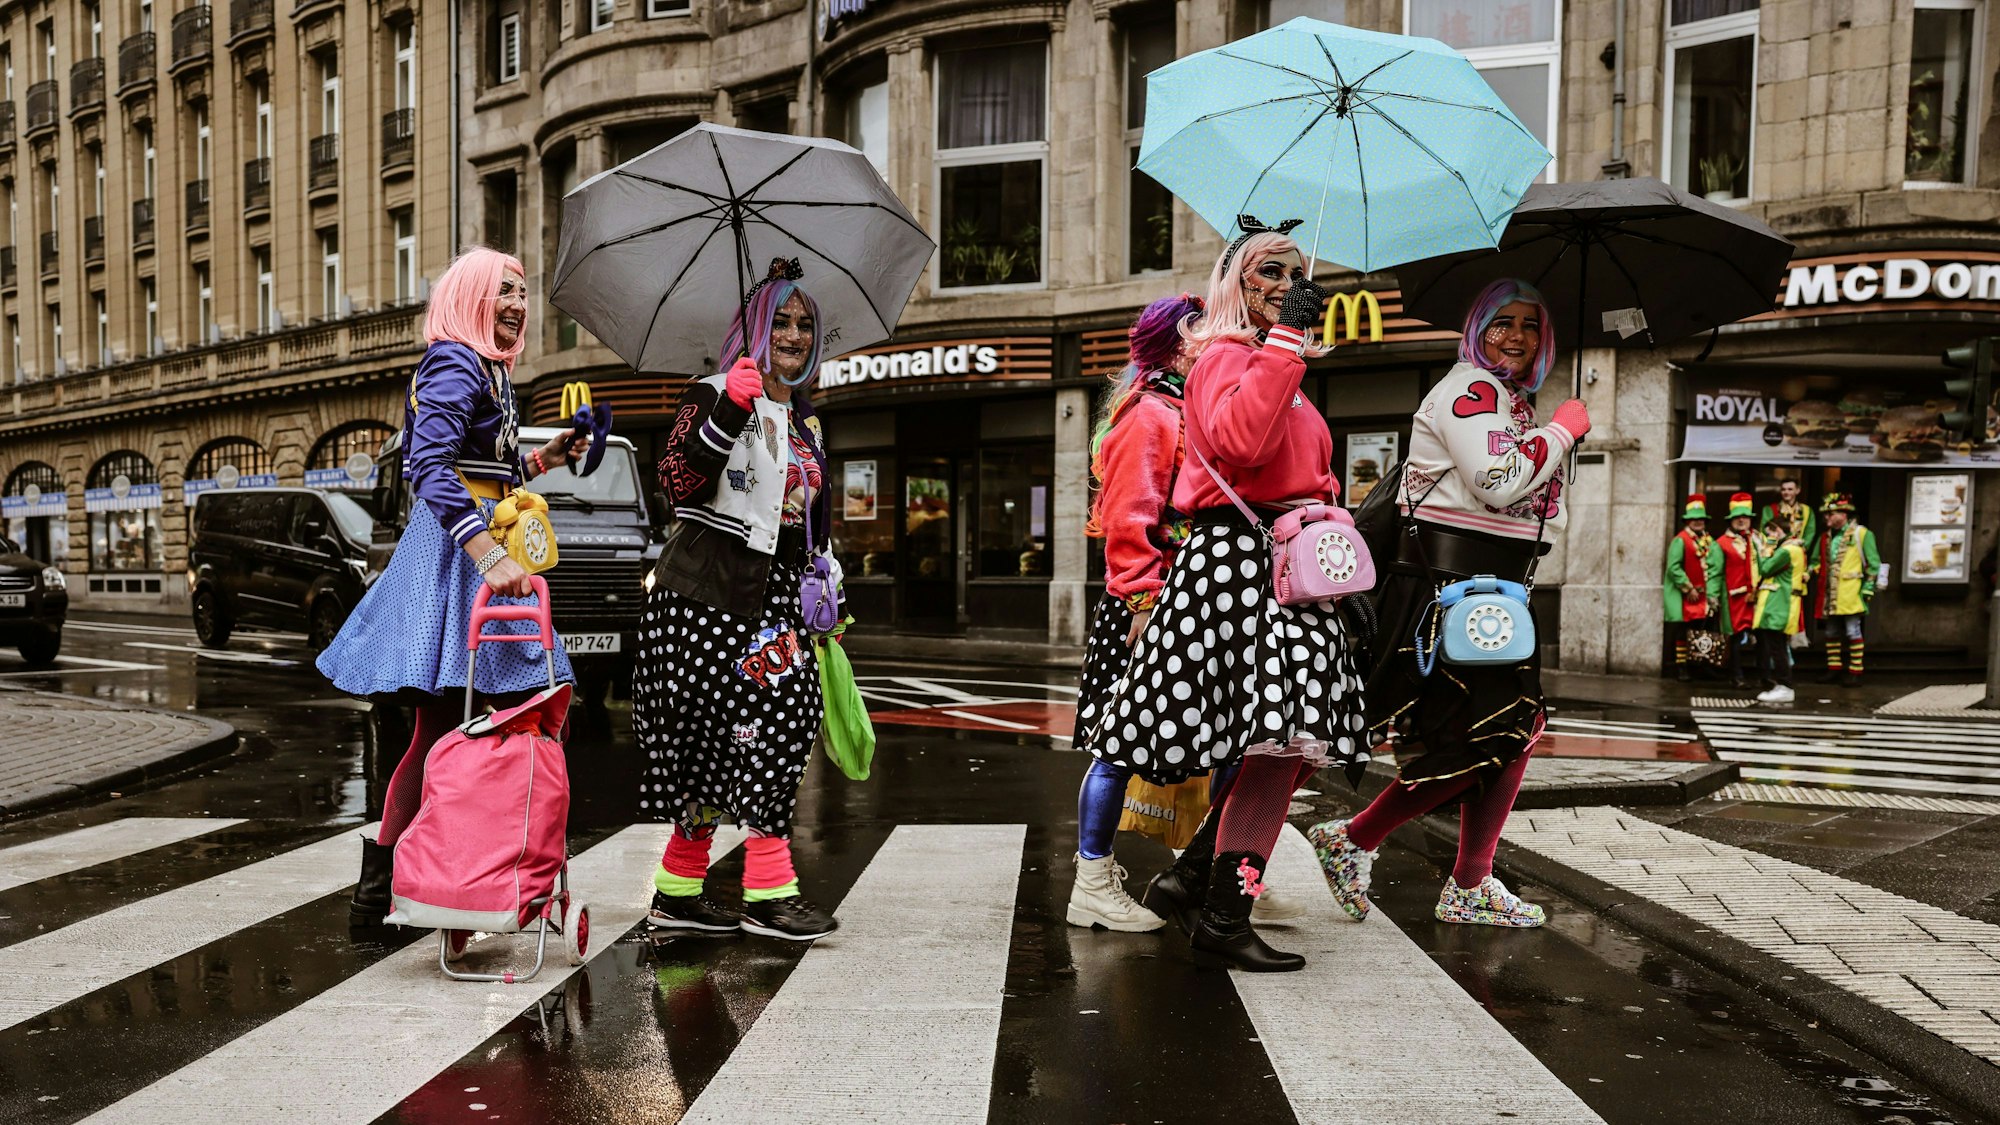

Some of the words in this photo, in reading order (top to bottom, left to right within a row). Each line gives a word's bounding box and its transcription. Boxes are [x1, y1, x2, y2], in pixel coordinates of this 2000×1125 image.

[1783, 259, 2000, 306] McDon
[818, 344, 998, 389] McDonald's
[1696, 394, 1786, 425] ROYAL
[570, 535, 630, 543] ROVER
[564, 636, 583, 651] MP
[587, 635, 615, 651] 747
